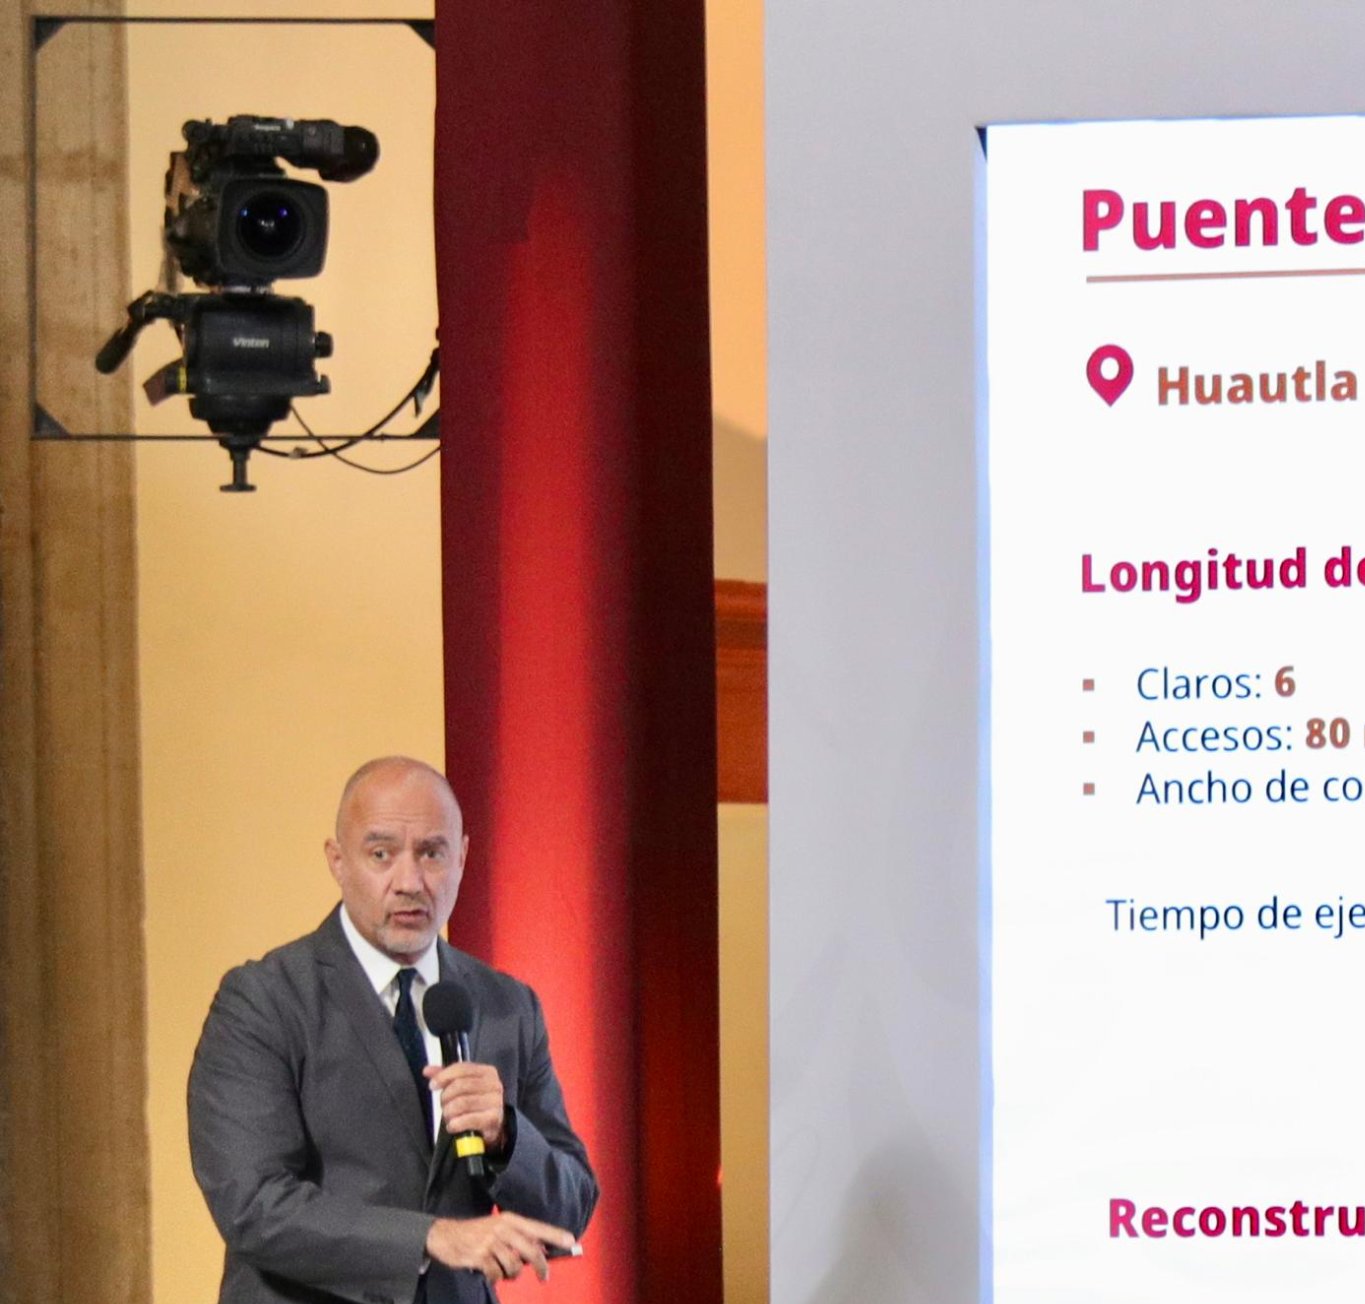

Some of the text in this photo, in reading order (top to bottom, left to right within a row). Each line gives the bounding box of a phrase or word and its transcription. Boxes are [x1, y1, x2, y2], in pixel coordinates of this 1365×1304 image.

[1157, 359, 1358, 406] Huautla
[1081, 545, 1308, 604] Longitud
[1136, 665, 1297, 702] Claros: 6
[1135, 719, 1293, 753] Accesos:
[1305, 716, 1351, 750] 80
[1135, 768, 1253, 805] Ancho
[1265, 768, 1310, 804] de
[1104, 897, 1245, 941] Tiempo
[1257, 894, 1303, 931] de
